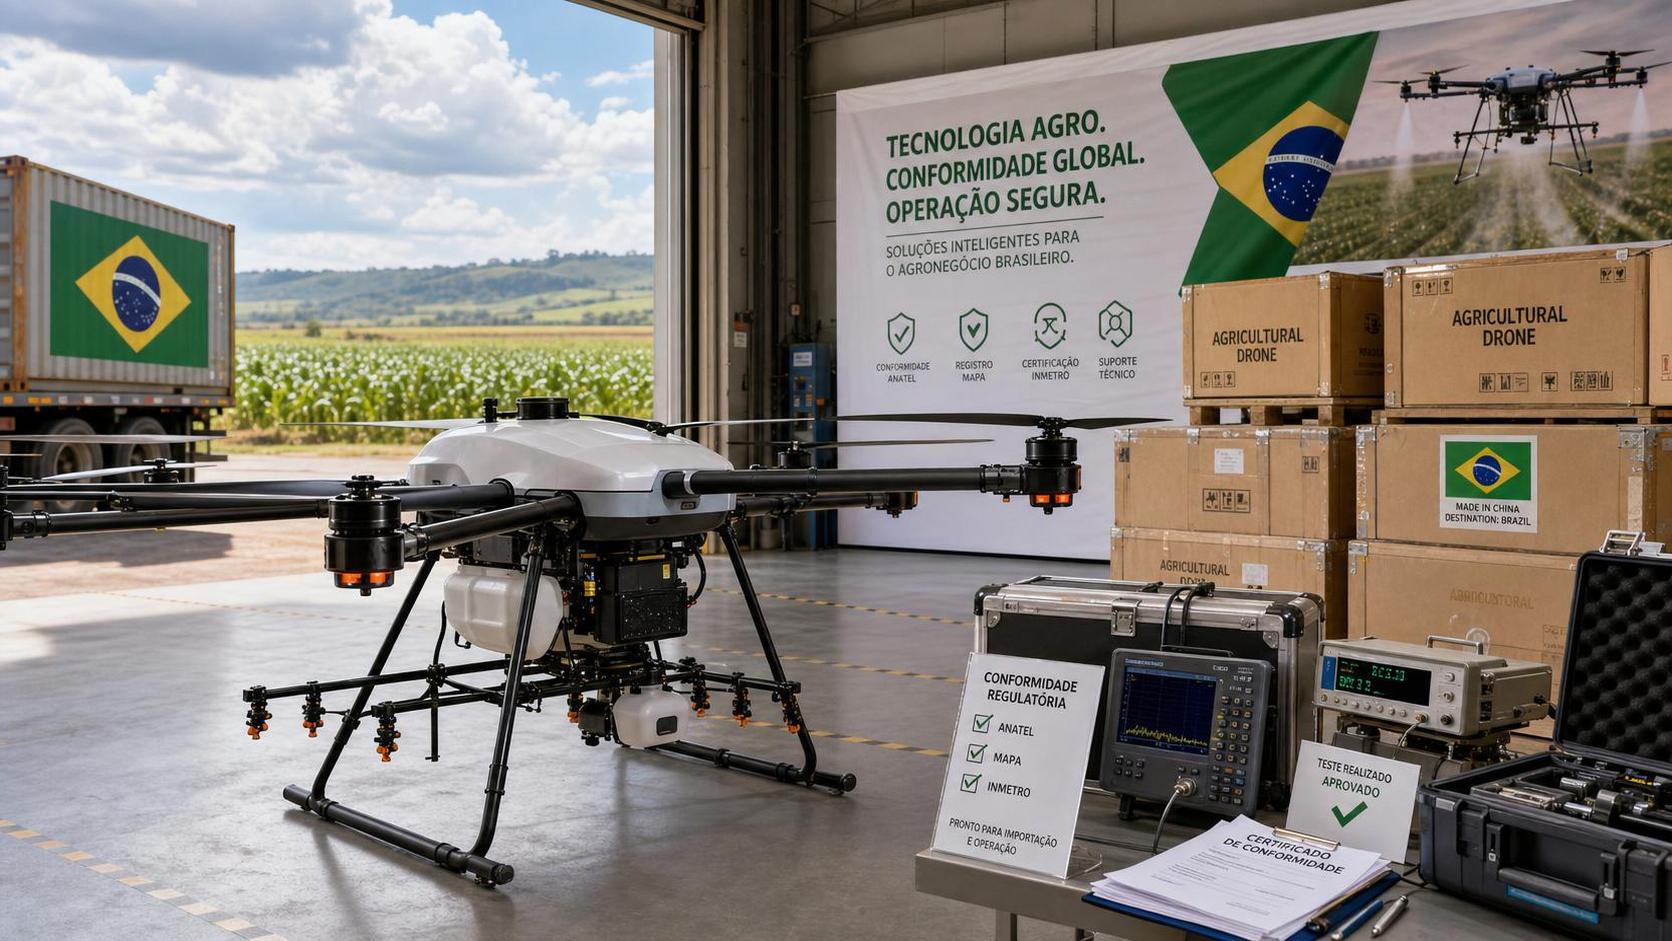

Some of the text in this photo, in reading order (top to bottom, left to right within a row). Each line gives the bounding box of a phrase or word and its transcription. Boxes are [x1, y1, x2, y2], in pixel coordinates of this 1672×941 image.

[886, 109, 1106, 158] TECNOLOGIA AGRO.
[886, 140, 1145, 191] CONFORMIDADE GLOBAL.
[886, 180, 1106, 224] OPERAÇÃO SEGURA.
[886, 230, 1080, 259] SOLUÇÕES INTELIGENTES PARA
[886, 250, 1075, 277] O AGRONEGÓCIO BRASILEIRO.
[1452, 305, 1568, 327] AGRICULTURAL
[1212, 327, 1304, 346] AGRICULTURAL
[1483, 328, 1536, 347] DRONE
[1098, 356, 1137, 367] SUPORTE
[1236, 346, 1278, 363] DRONE
[876, 361, 930, 372] CONFORMIDADE
[955, 359, 994, 370] REGISTRO
[1099, 367, 1136, 379] TÉCNICO
[887, 373, 917, 383] ANATEL
[962, 372, 986, 382] MAPA
[1031, 370, 1070, 380] INMETRO
[1455, 502, 1520, 513] MADE IN CHINA
[1445, 513, 1531, 526] DESTINATION: BRAZIL
[1160, 559, 1230, 576] AGRICULTURAL
[984, 671, 1078, 693] CONFORMIDADE
[987, 687, 1067, 709] REGULATÓRIA
[998, 722, 1034, 737] ANATEL
[993, 752, 1022, 766] MAPA
[1317, 757, 1392, 784] TESTE REALIZADO
[987, 782, 1031, 797] INMETRO
[1322, 775, 1381, 798] APROVADO
[949, 817, 1058, 849] PRONTO PARA IMPORTAÇÃO
[967, 837, 972, 847] E
[1223, 838, 1240, 849] DE
[1242, 843, 1345, 875] CONFORMIDADE
